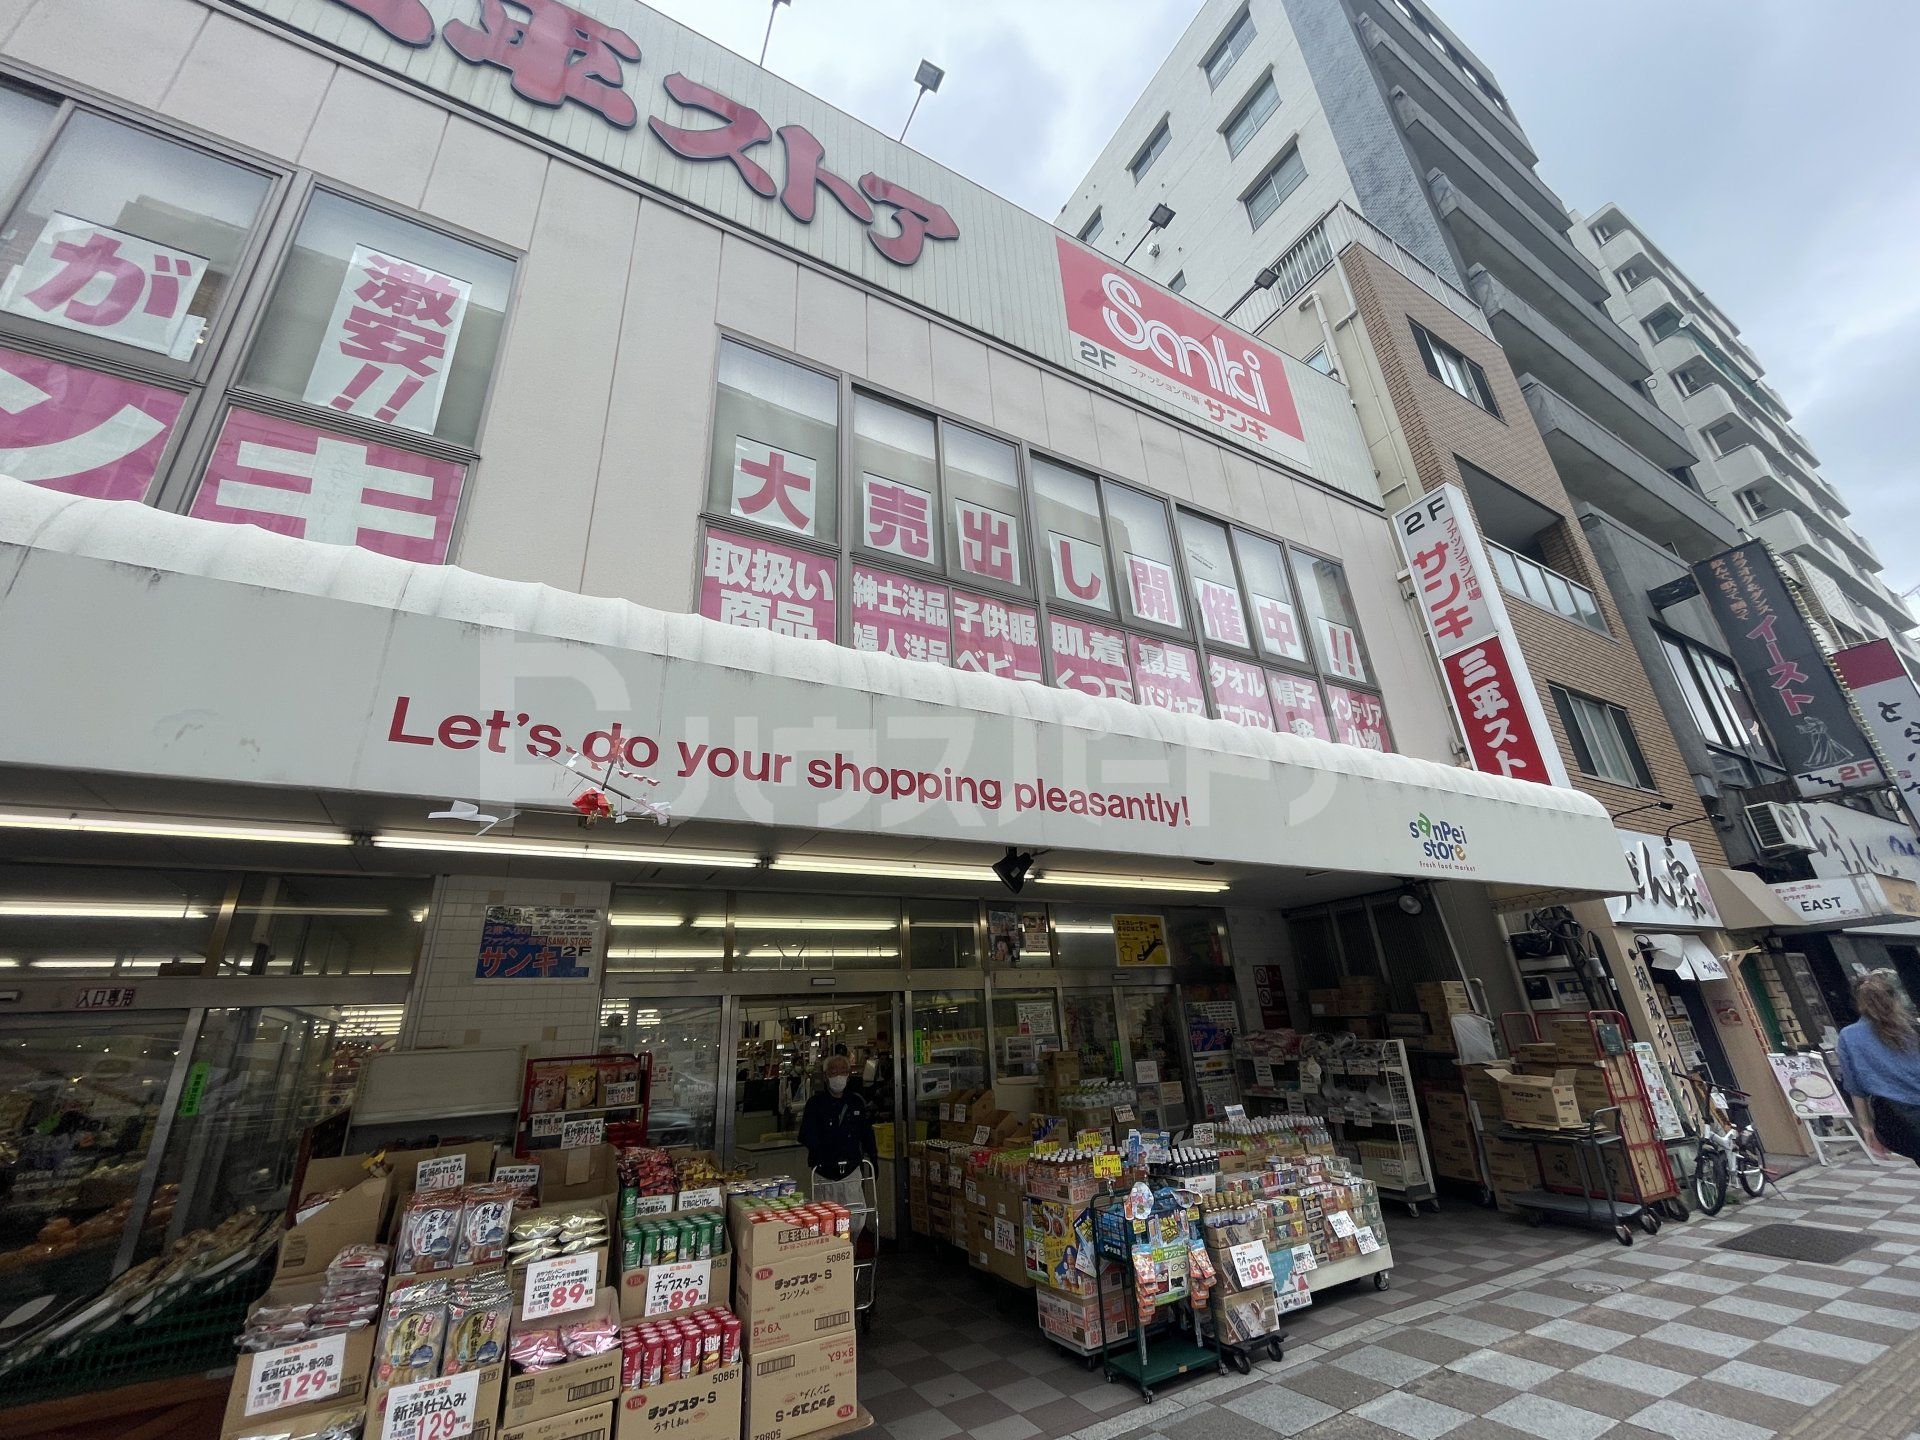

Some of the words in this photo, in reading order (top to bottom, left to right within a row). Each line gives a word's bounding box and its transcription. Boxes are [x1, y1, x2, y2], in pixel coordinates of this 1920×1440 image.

[24, 232, 193, 326] が
[1101, 272, 1271, 415] Sanki
[1080, 340, 1117, 370] 2F
[1129, 365, 1200, 406] ファッション市場
[1203, 398, 1269, 442] サンキ
[1404, 496, 1446, 536] 2F
[704, 537, 833, 601] 取扱い
[1443, 517, 1483, 602] ファッション市場
[853, 572, 948, 627] 紳士洋品
[1412, 541, 1473, 639] サンキ
[720, 588, 817, 641] 商品
[954, 597, 1037, 647] 子供服
[1052, 623, 1125, 667] 肌着
[956, 650, 1042, 681] ベビー
[1139, 643, 1191, 683] 寝具
[1746, 615, 1814, 718] イースト
[1056, 669, 1133, 703] くつ下
[1210, 662, 1265, 698] タオル
[1273, 678, 1317, 711] 帽子
[1140, 685, 1205, 718] パジャマ
[1217, 704, 1274, 732] エプロン
[1331, 696, 1384, 729] インテリア
[387, 696, 562, 756] Let's
[582, 721, 660, 768] do
[676, 740, 792, 785] your
[807, 753, 1001, 810] shopping
[1014, 777, 1191, 828] pleasantly!
[1838, 759, 1877, 783] 2F
[1801, 896, 1842, 912] EAST
[480, 945, 559, 978] サンキ
[562, 946, 592, 957] 2F
[78, 988, 135, 1008] 入口専用
[575, 1133, 596, 1146] 248
[430, 1173, 456, 1189] 218
[826, 1251, 851, 1264] 50862
[1249, 1262, 1265, 1279] 89
[655, 1274, 704, 1293] チップスターS
[657, 1272, 675, 1280] YBC
[550, 1283, 585, 1308] 89
[669, 1288, 699, 1311] 89
[283, 1369, 328, 1401] 129
[712, 1368, 740, 1384] 50861
[392, 1392, 467, 1422] 新潟仕込み
[417, 1409, 456, 1440] 129
